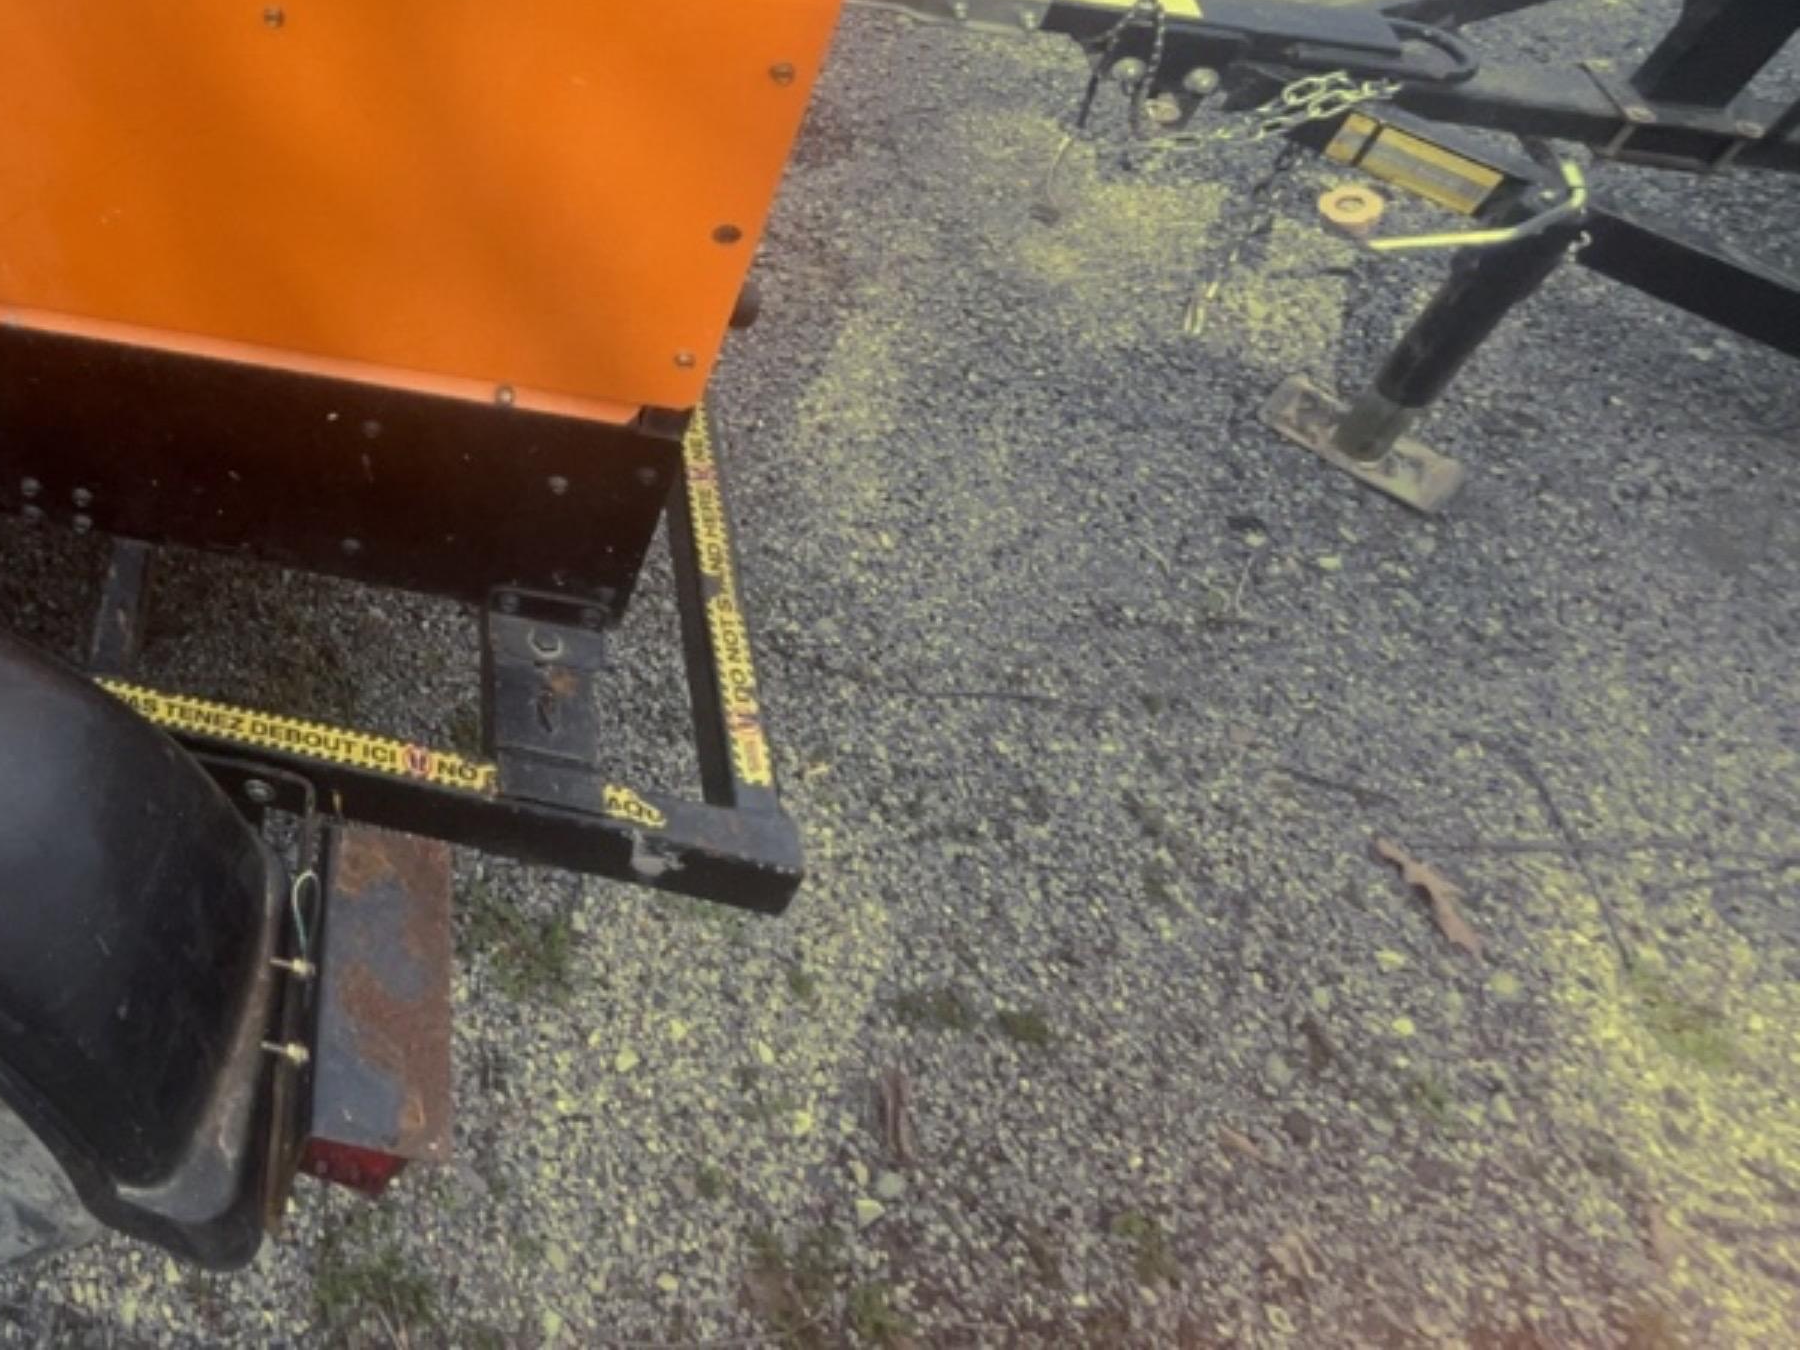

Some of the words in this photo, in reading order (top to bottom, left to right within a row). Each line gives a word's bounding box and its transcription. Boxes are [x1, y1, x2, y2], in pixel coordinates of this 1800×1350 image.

[720, 615, 742, 664] NOT
[251, 721, 356, 757] DEBOUT
[363, 744, 397, 763] ICI
